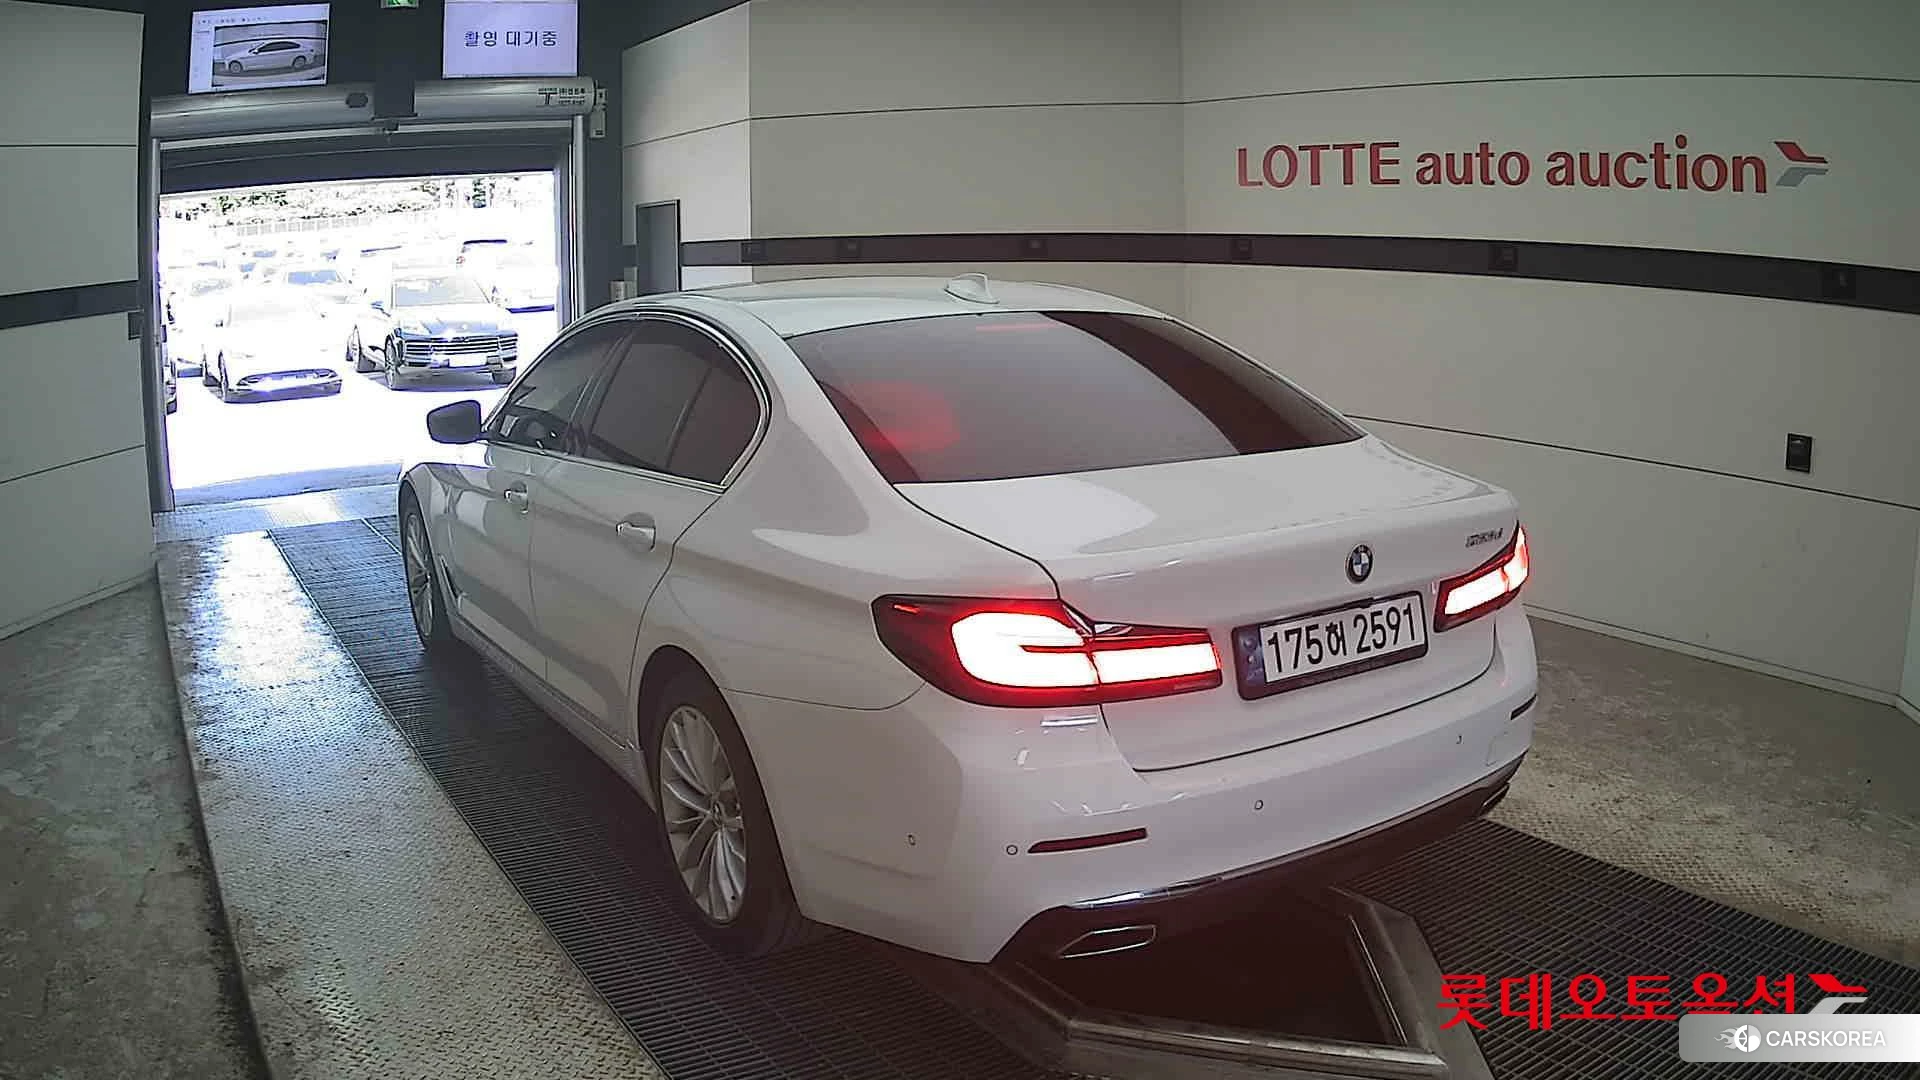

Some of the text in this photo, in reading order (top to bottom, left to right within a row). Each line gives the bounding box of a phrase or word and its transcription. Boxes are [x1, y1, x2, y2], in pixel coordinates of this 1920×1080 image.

[505, 31, 558, 47] 대기중
[1235, 134, 1768, 194] LOTTE auto auction
[1267, 602, 1416, 673] 175허 2591
